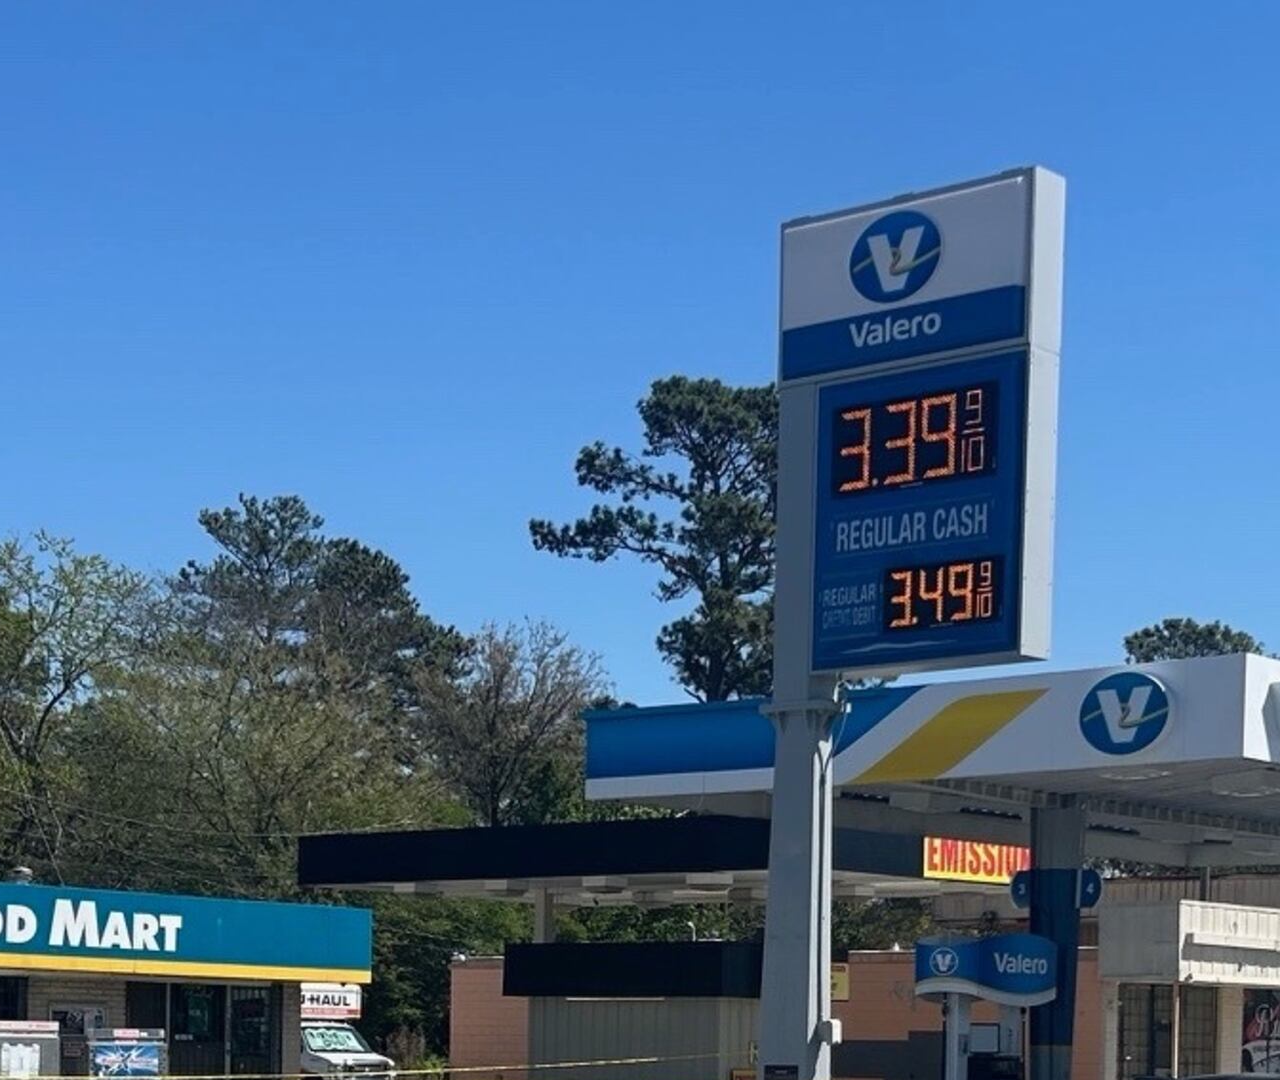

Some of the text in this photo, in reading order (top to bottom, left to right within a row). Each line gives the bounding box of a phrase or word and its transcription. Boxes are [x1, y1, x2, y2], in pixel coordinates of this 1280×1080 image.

[849, 311, 942, 348] Valero
[839, 393, 957, 492] 3.39
[836, 503, 988, 552] REGULAR CASH
[822, 583, 876, 607] REGULAR
[889, 563, 974, 628] 3.49
[1086, 883, 1095, 894] 4
[48, 898, 183, 952] MART
[993, 952, 1048, 974] Valero
